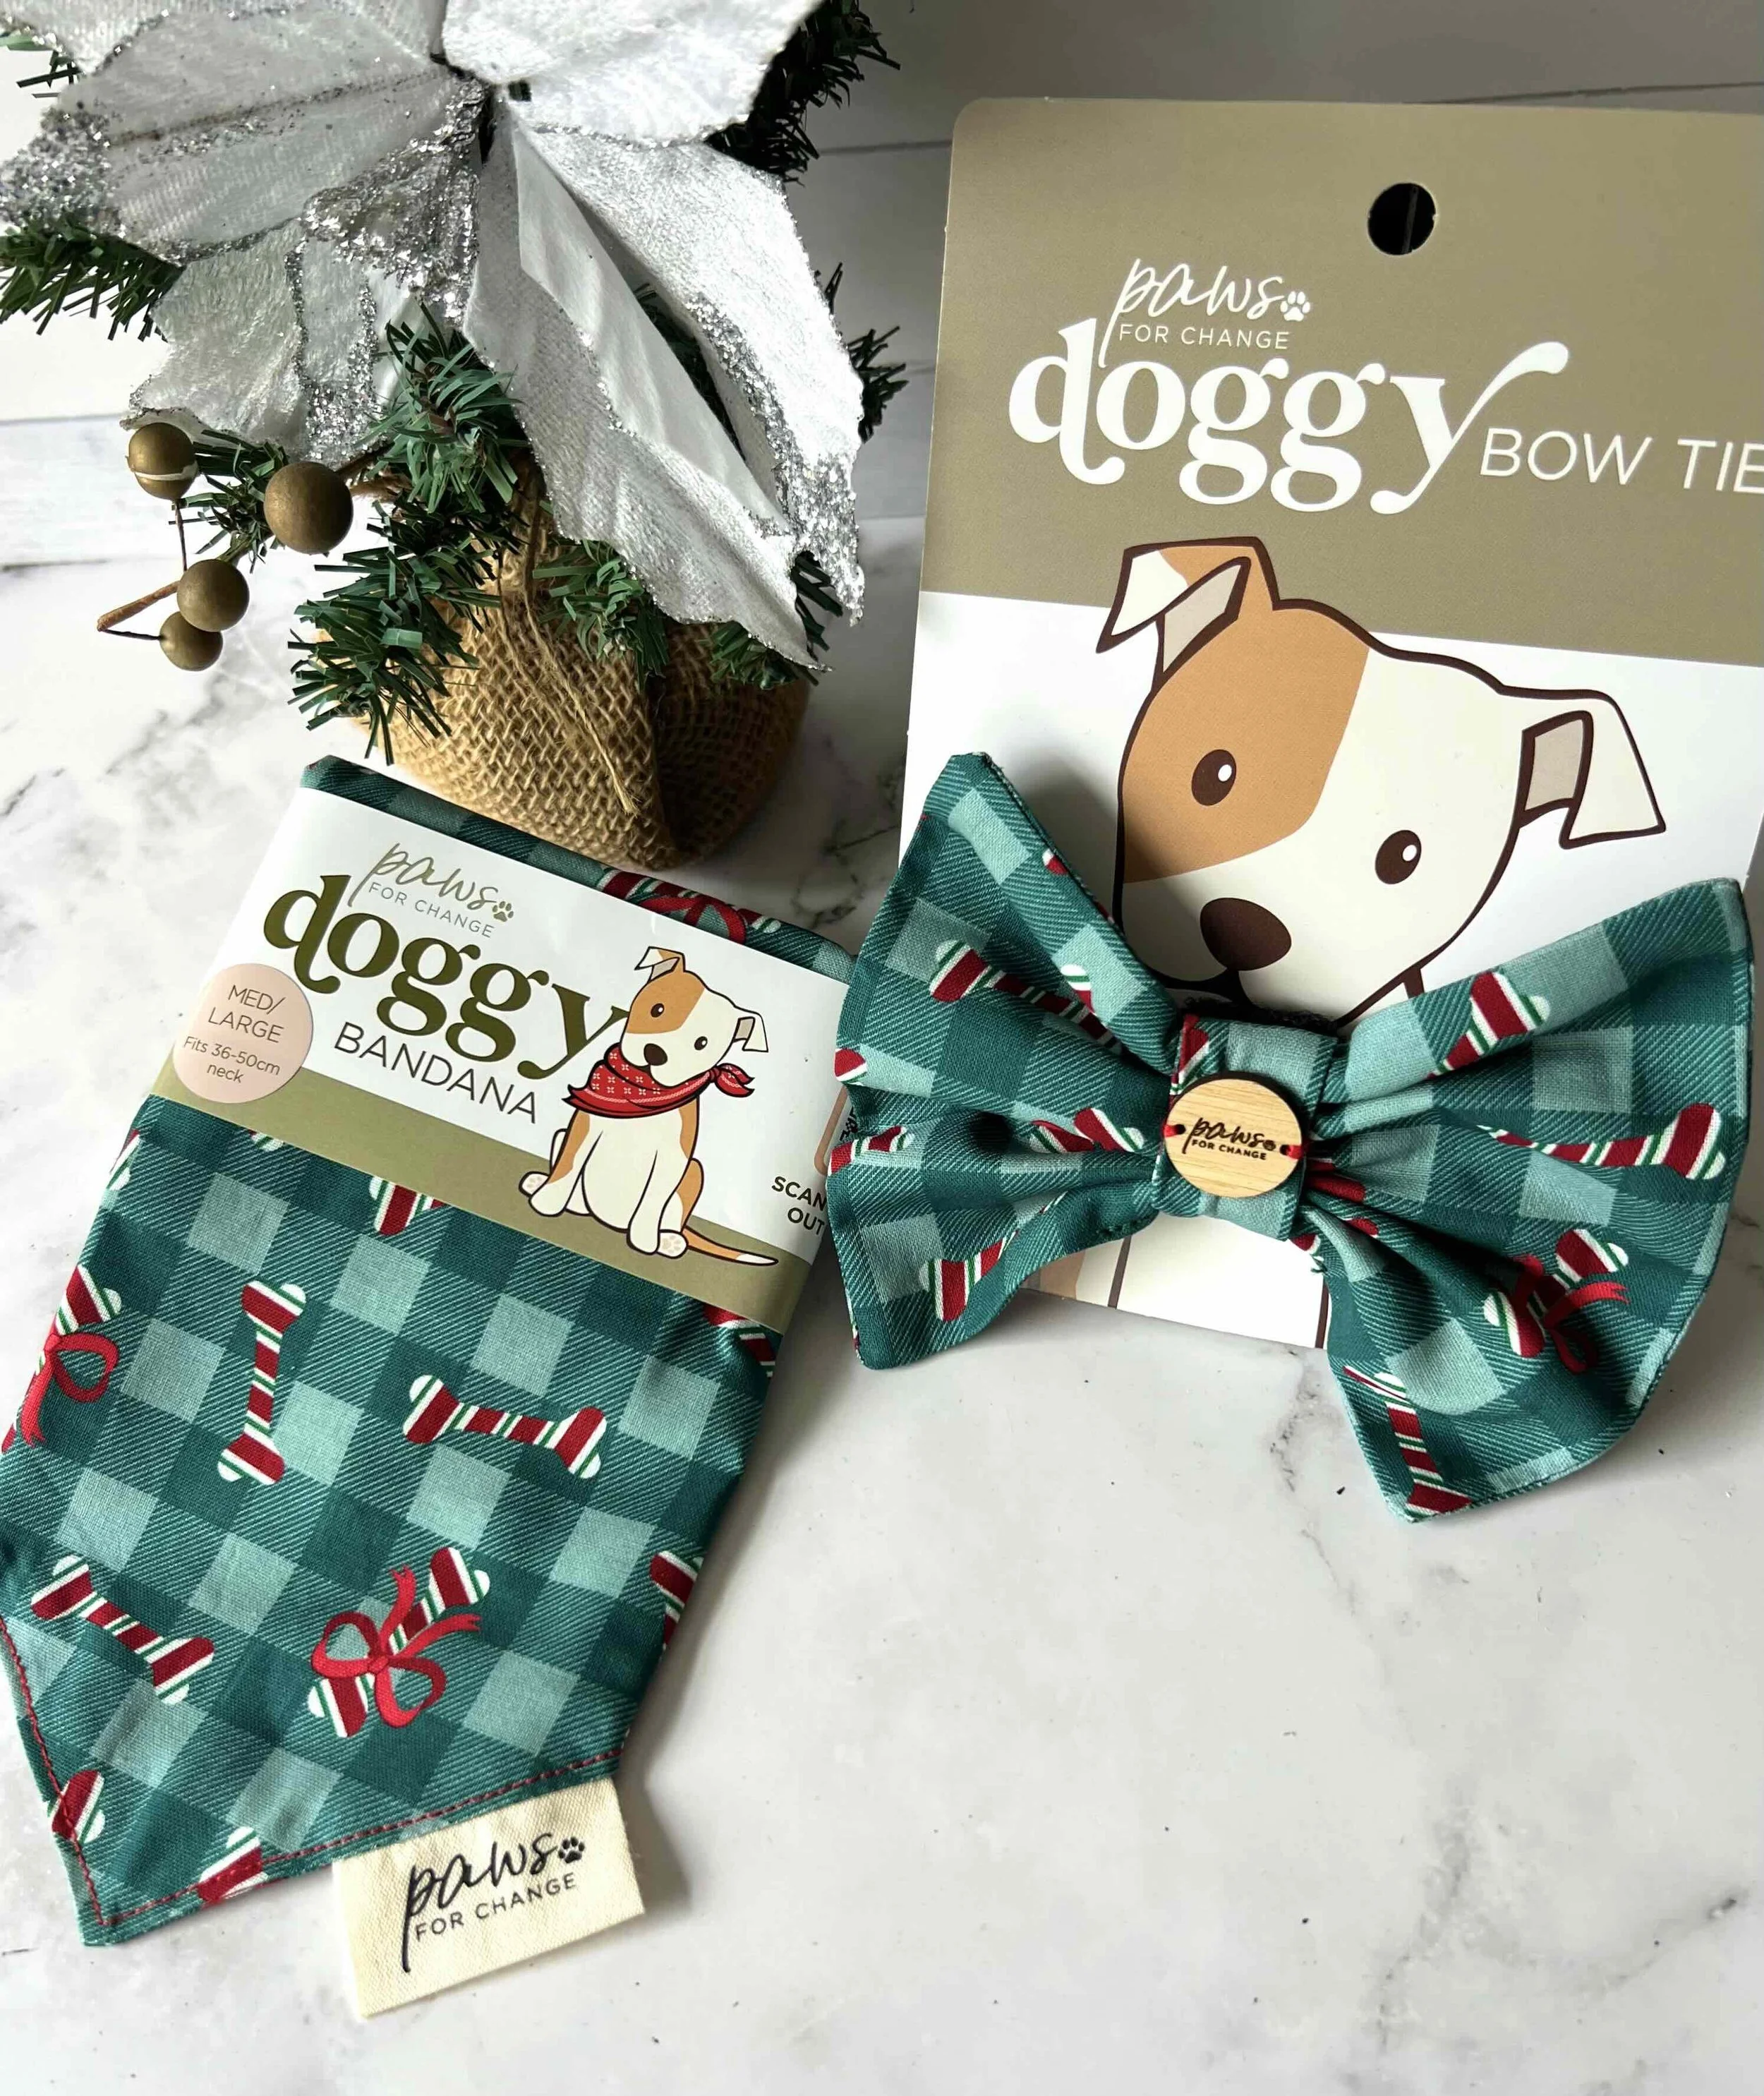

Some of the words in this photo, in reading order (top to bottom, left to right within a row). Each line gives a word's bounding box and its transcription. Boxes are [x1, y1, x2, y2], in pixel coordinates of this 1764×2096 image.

[1099, 258, 1283, 368] paws
[1119, 324, 1168, 344] FOR
[1181, 327, 1290, 350] CHANGE
[1009, 318, 1569, 514] doggy
[1480, 427, 1653, 486] BOW
[1677, 438, 1764, 495] TIE
[346, 842, 499, 911] paws
[368, 881, 408, 906] FOR
[415, 899, 495, 939] CHANGE
[228, 984, 286, 1015] MED/
[263, 874, 629, 1080] doggy
[208, 1007, 284, 1044] LARGE
[183, 1036, 209, 1054] Fits
[211, 1042, 281, 1076] 36-50cm
[207, 1064, 246, 1083] neck
[334, 1021, 536, 1124] BANDANA
[1181, 1116, 1265, 1155] paws
[1192, 1139, 1215, 1150] FOR
[1219, 1143, 1267, 1161] CHANGE
[771, 1176, 826, 1212] SCAN
[787, 1207, 826, 1236] OUT
[401, 1832, 558, 1973] paws
[416, 1912, 465, 1942] FOR
[476, 1872, 577, 1920] CHANGE
